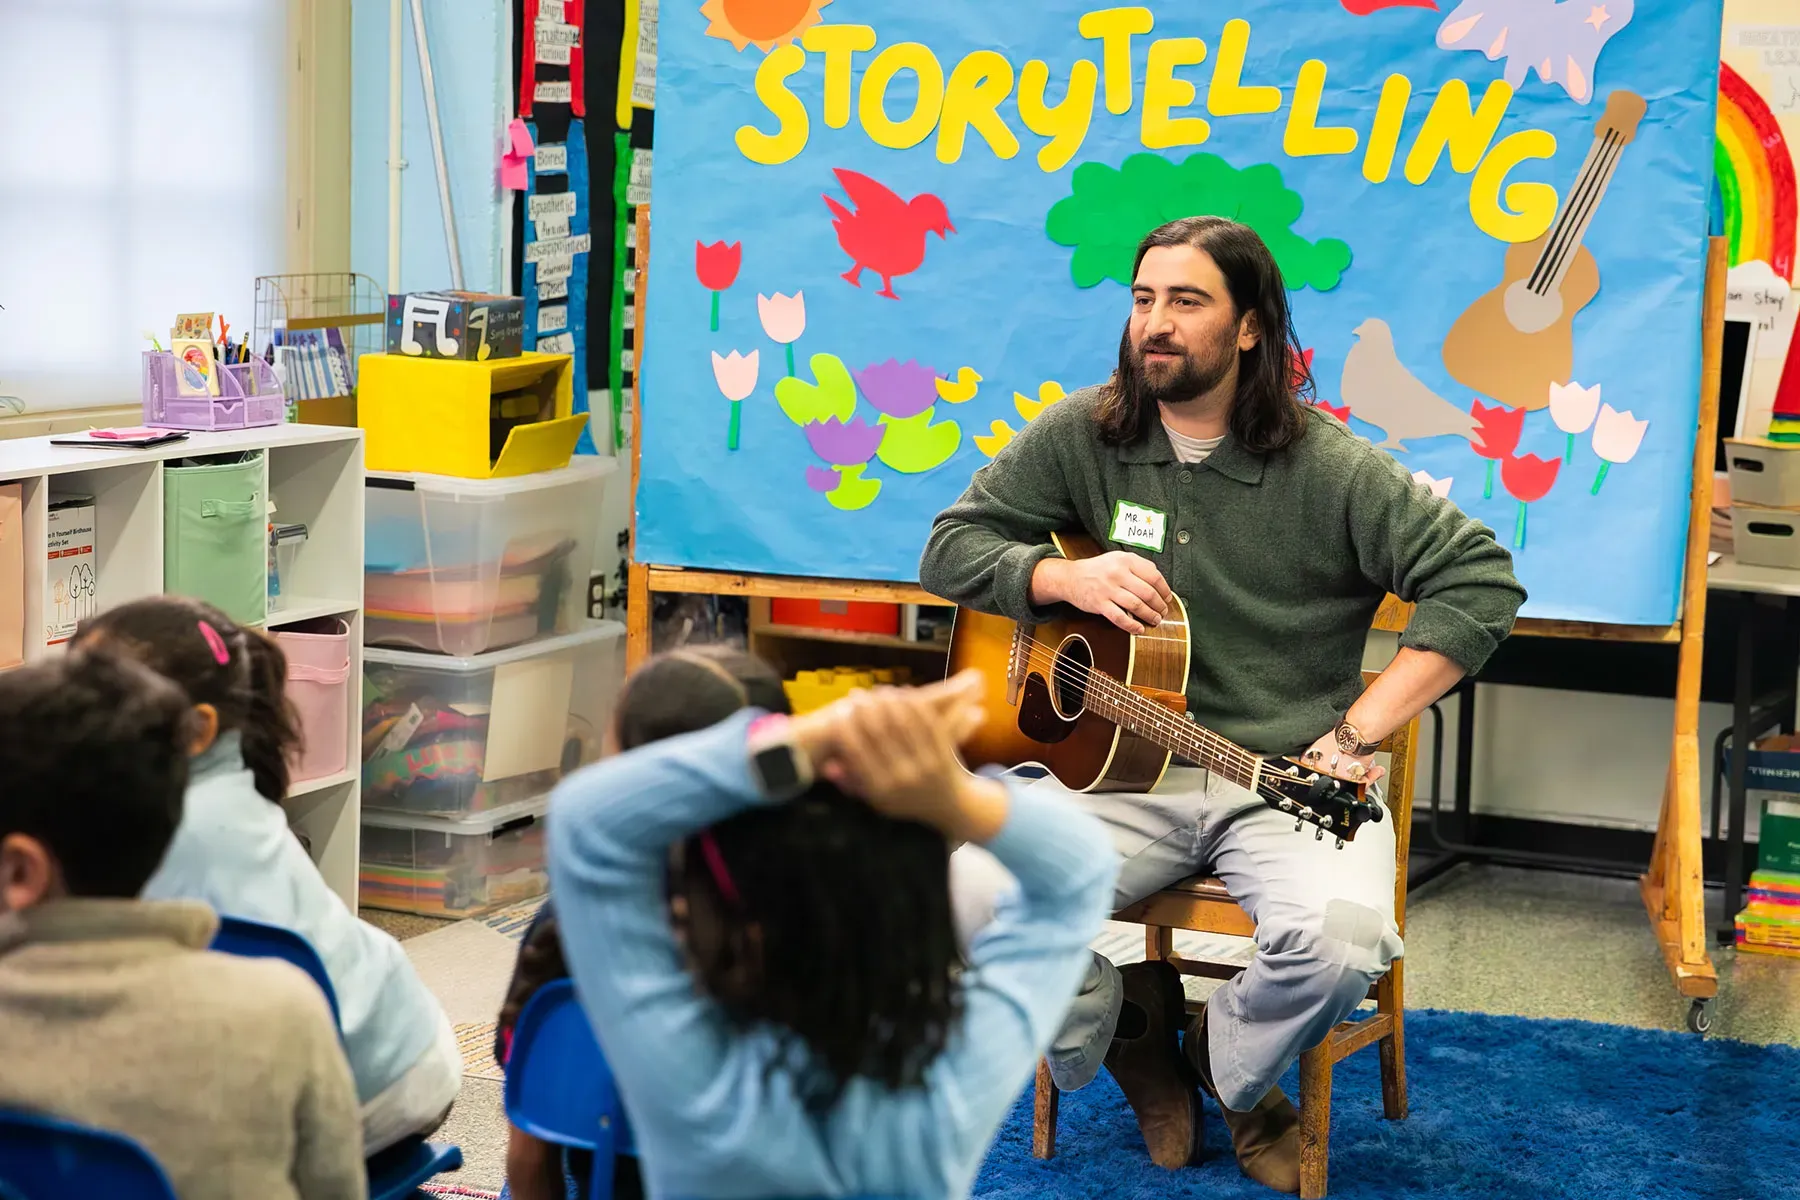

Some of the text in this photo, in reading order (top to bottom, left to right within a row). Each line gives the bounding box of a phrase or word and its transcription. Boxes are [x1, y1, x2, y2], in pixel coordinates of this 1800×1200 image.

[735, 6, 1558, 243] STORYTELLING
[537, 150, 565, 168] Bored
[528, 235, 589, 258] Disappointed
[1776, 255, 1789, 277] 4
[542, 308, 566, 328] Tired
[56, 529, 73, 537] Yourself
[73, 527, 92, 535] Birdhouse
[1127, 525, 1154, 539] NOAH
